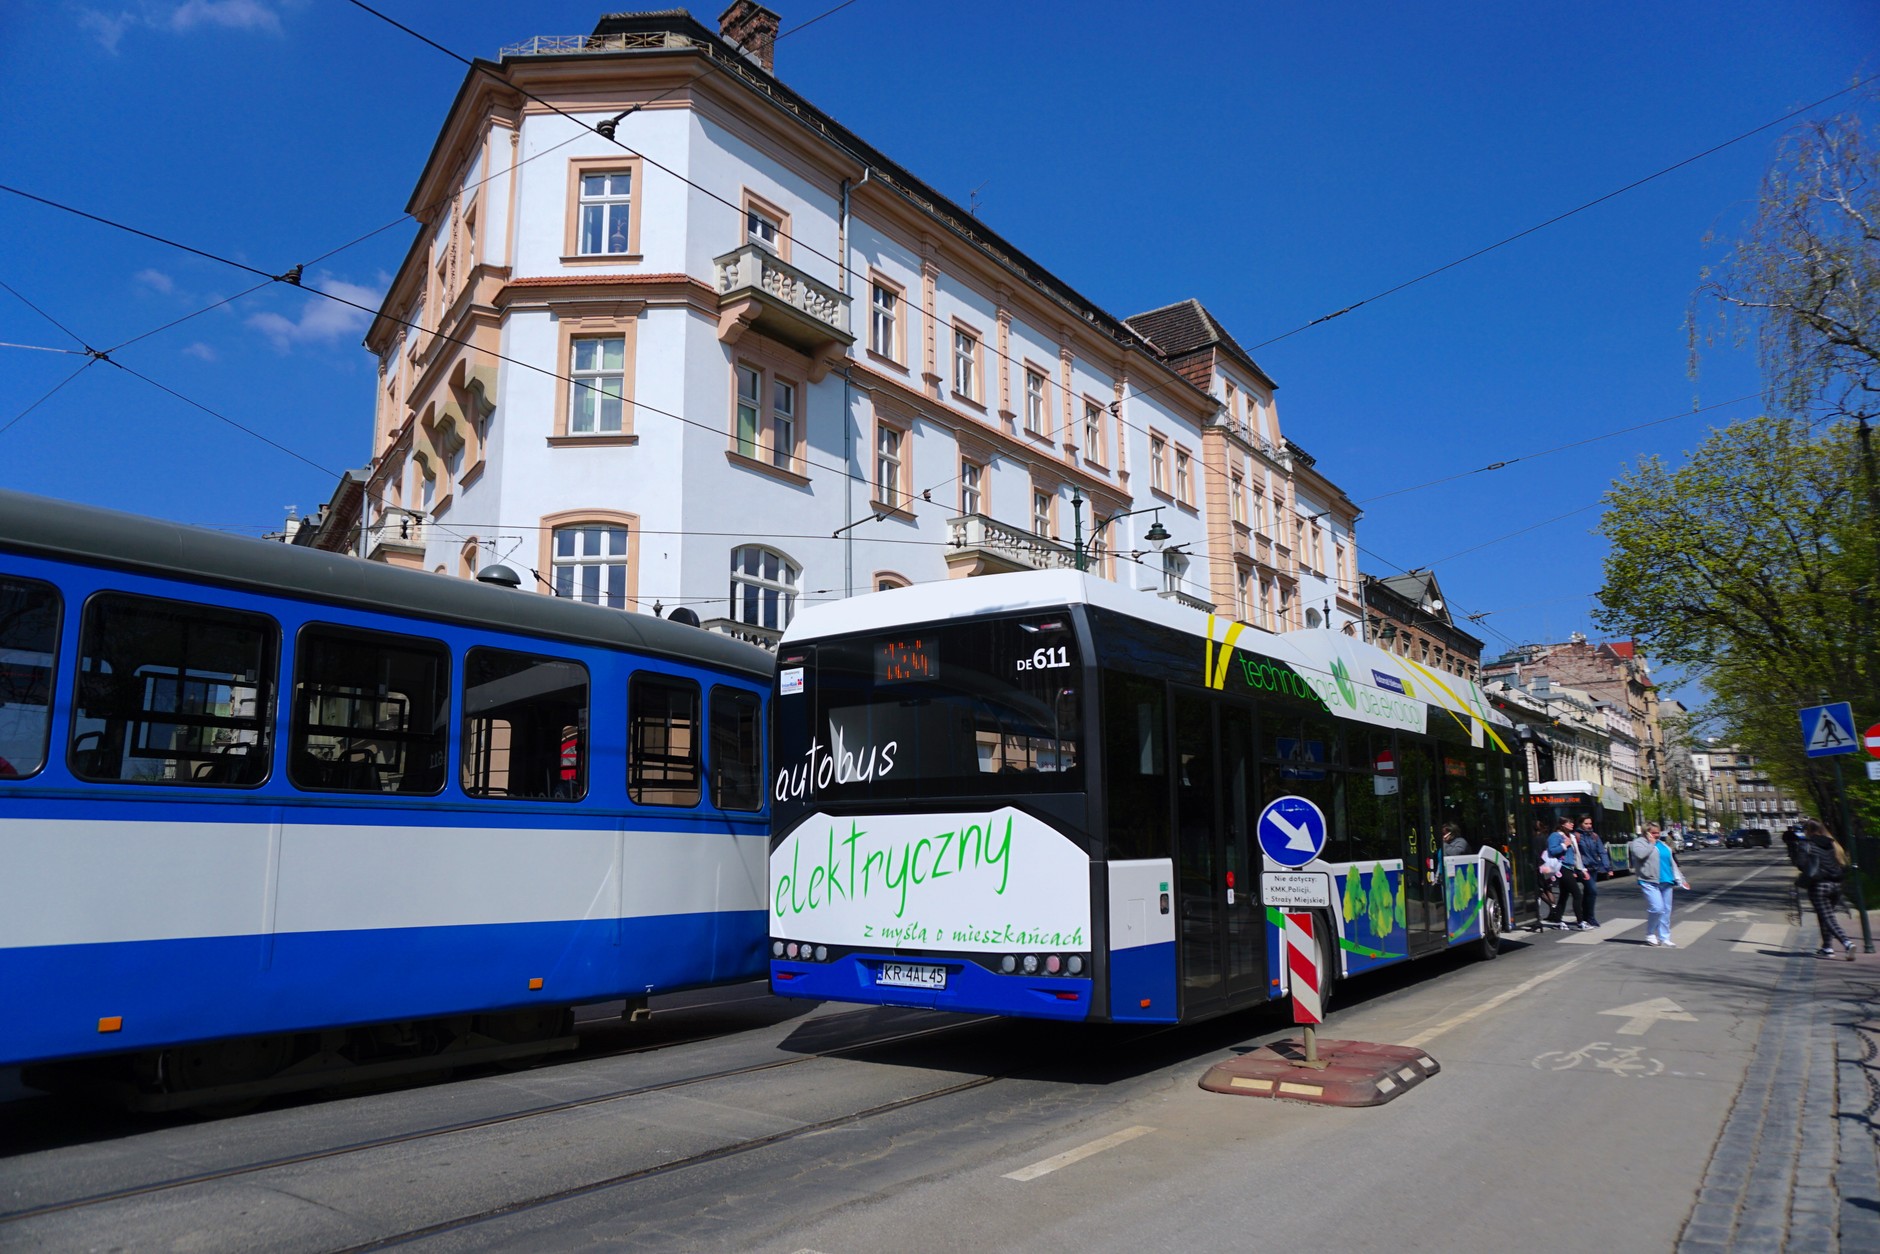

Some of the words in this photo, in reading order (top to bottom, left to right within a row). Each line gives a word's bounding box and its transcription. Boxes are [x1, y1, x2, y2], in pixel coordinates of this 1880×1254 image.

[1238, 651, 1342, 712] technologia
[775, 725, 897, 801] autobus
[775, 814, 1012, 918] elektryczny
[1271, 895, 1291, 904] Straży
[1294, 896, 1326, 905] Miejskiej
[864, 924, 873, 938] z
[881, 921, 927, 947] myślą
[936, 927, 943, 937] o
[952, 924, 1084, 947] mieszkańcach
[884, 965, 902, 981] KR
